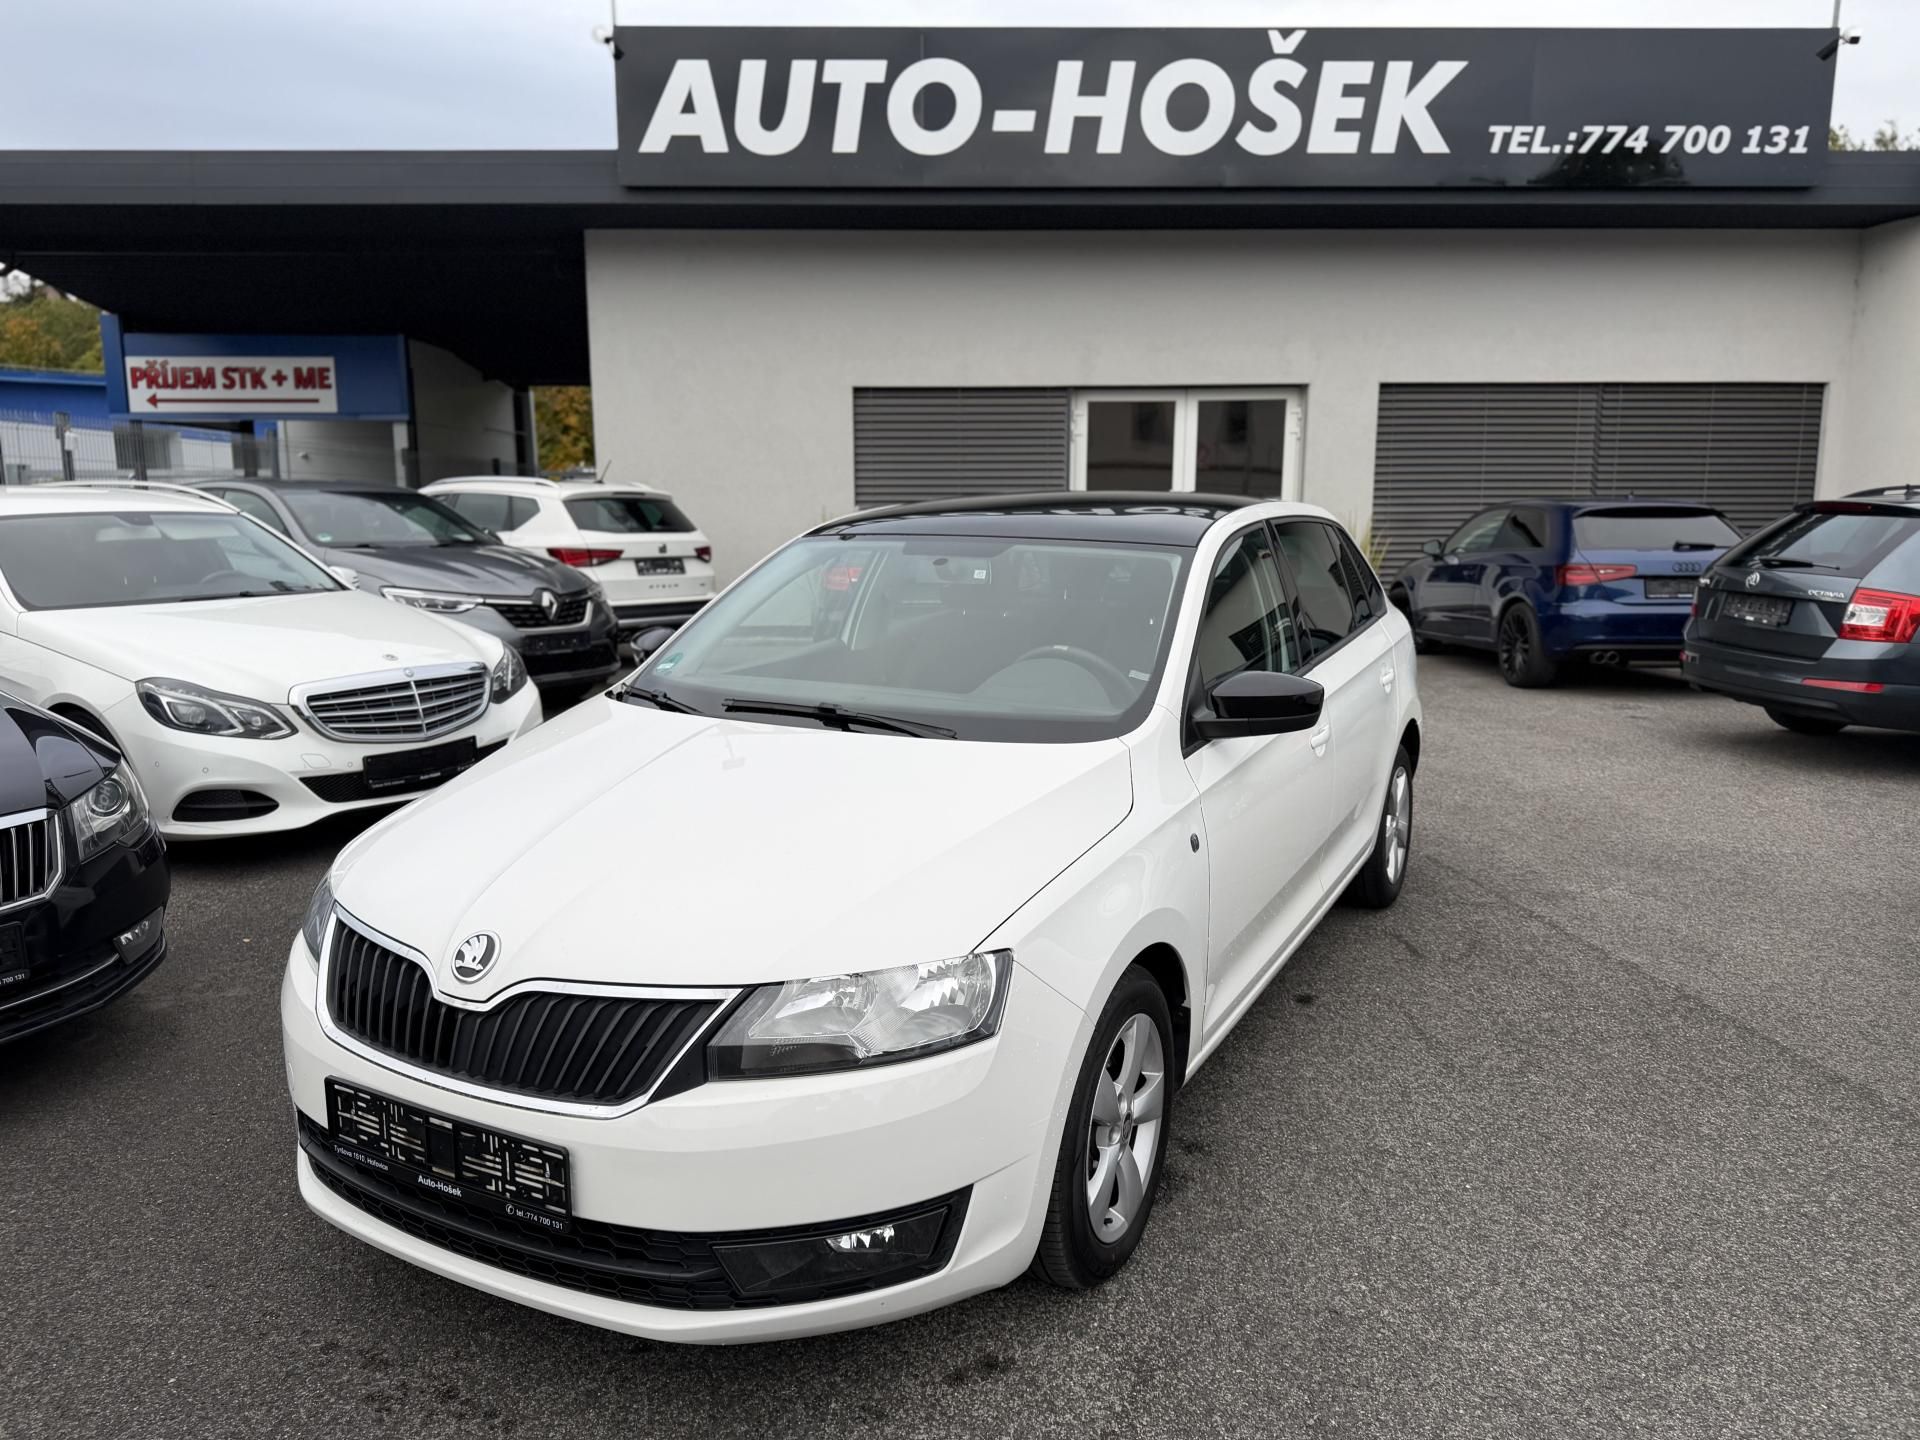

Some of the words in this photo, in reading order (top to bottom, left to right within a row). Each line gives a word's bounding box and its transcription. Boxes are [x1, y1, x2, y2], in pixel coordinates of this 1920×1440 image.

[638, 29, 1469, 157] AUTO-HOŠEK
[1487, 124, 1648, 155] TEL.:774
[1659, 124, 1731, 155] 700
[1741, 124, 1810, 155] 131
[130, 359, 216, 390] PŘÍJEM
[221, 366, 269, 390] STK
[293, 367, 332, 390] ME
[417, 1174, 463, 1198] Auto-Hošek
[538, 1215, 551, 1226] 700
[552, 1219, 563, 1230] 131
